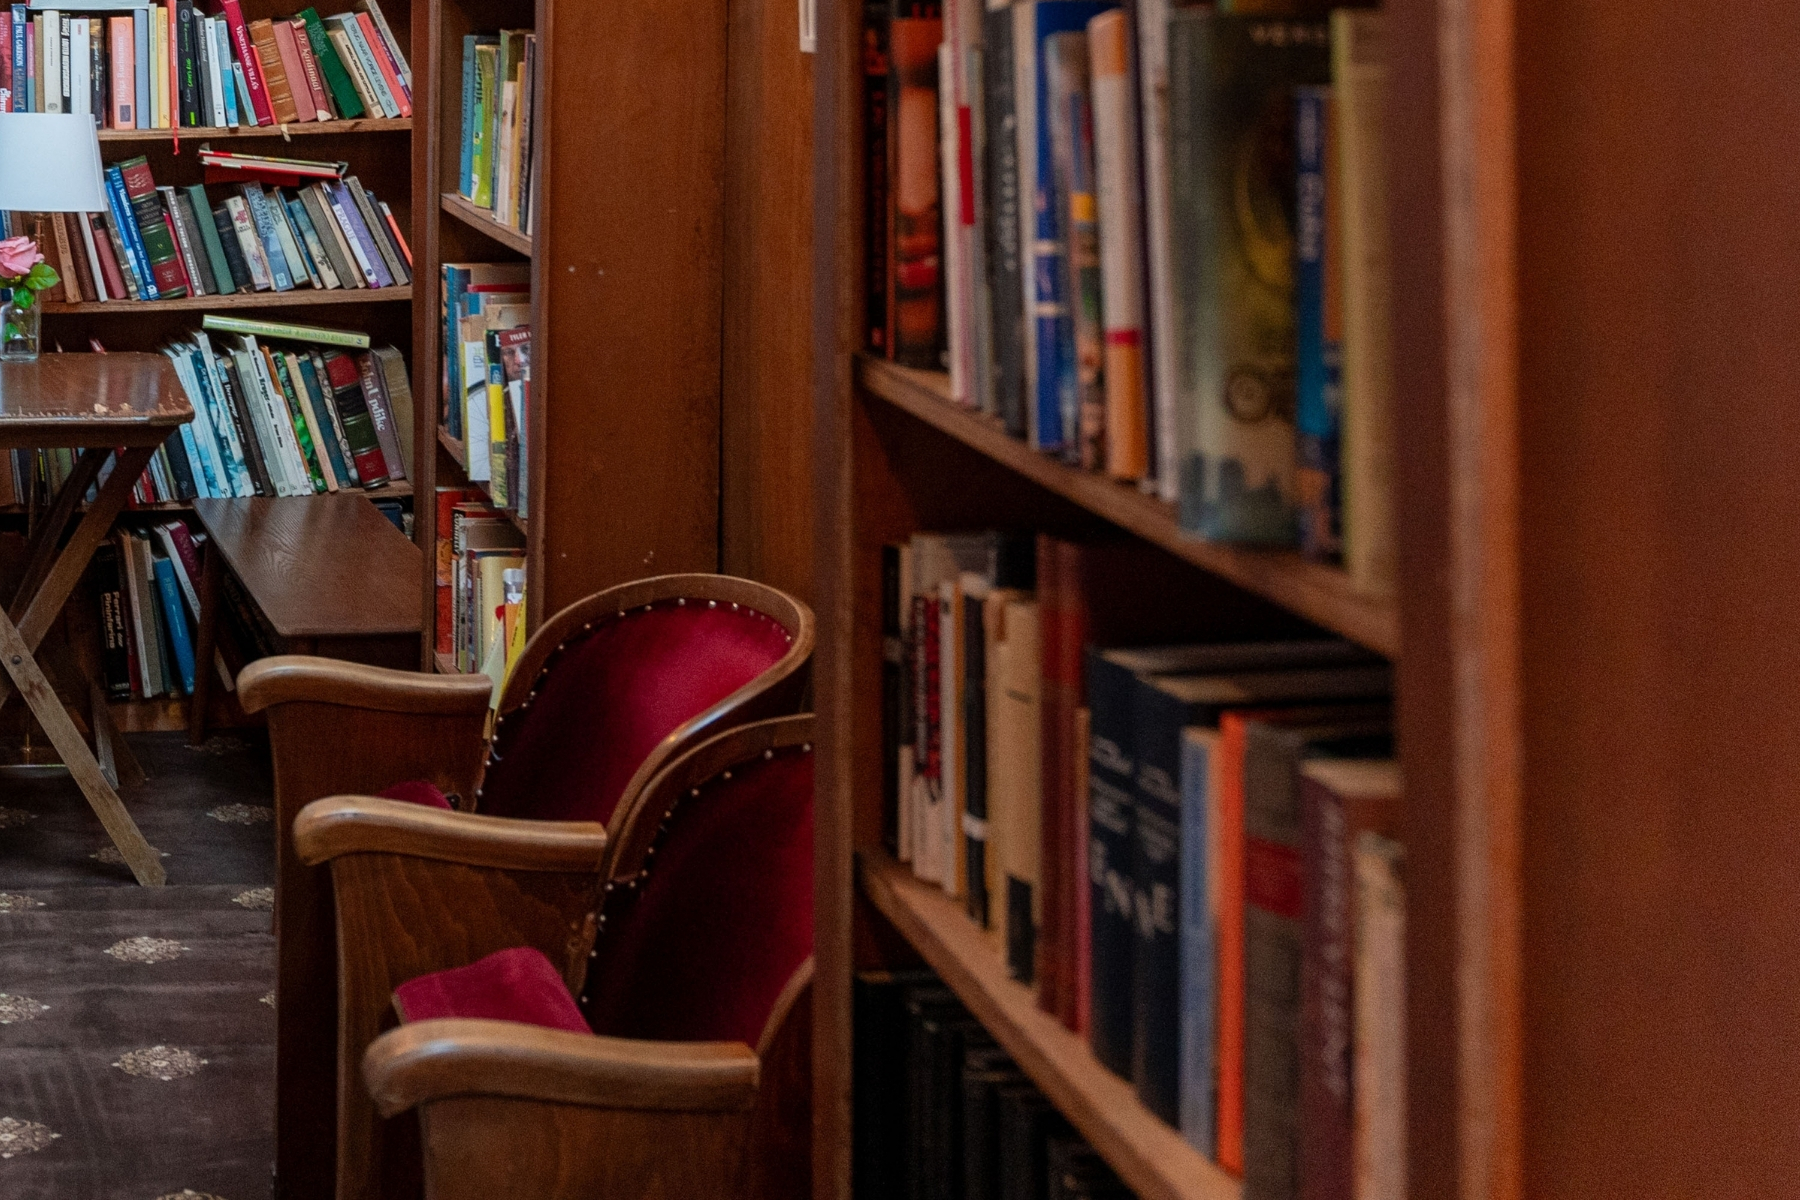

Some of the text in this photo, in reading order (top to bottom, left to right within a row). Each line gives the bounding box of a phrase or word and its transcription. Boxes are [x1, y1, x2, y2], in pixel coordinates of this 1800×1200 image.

[15, 25, 24, 67] PAUL GARRISON
[236, 25, 253, 68] VENETIAANSE
[298, 33, 307, 45] De
[356, 41, 367, 57] NAAR
[334, 207, 357, 242] PRAGUE
[360, 359, 387, 432] John Updike
[452, 513, 462, 554] CONNELLY
[103, 592, 116, 649] Pininfarina
[112, 591, 122, 630] Ferrari
